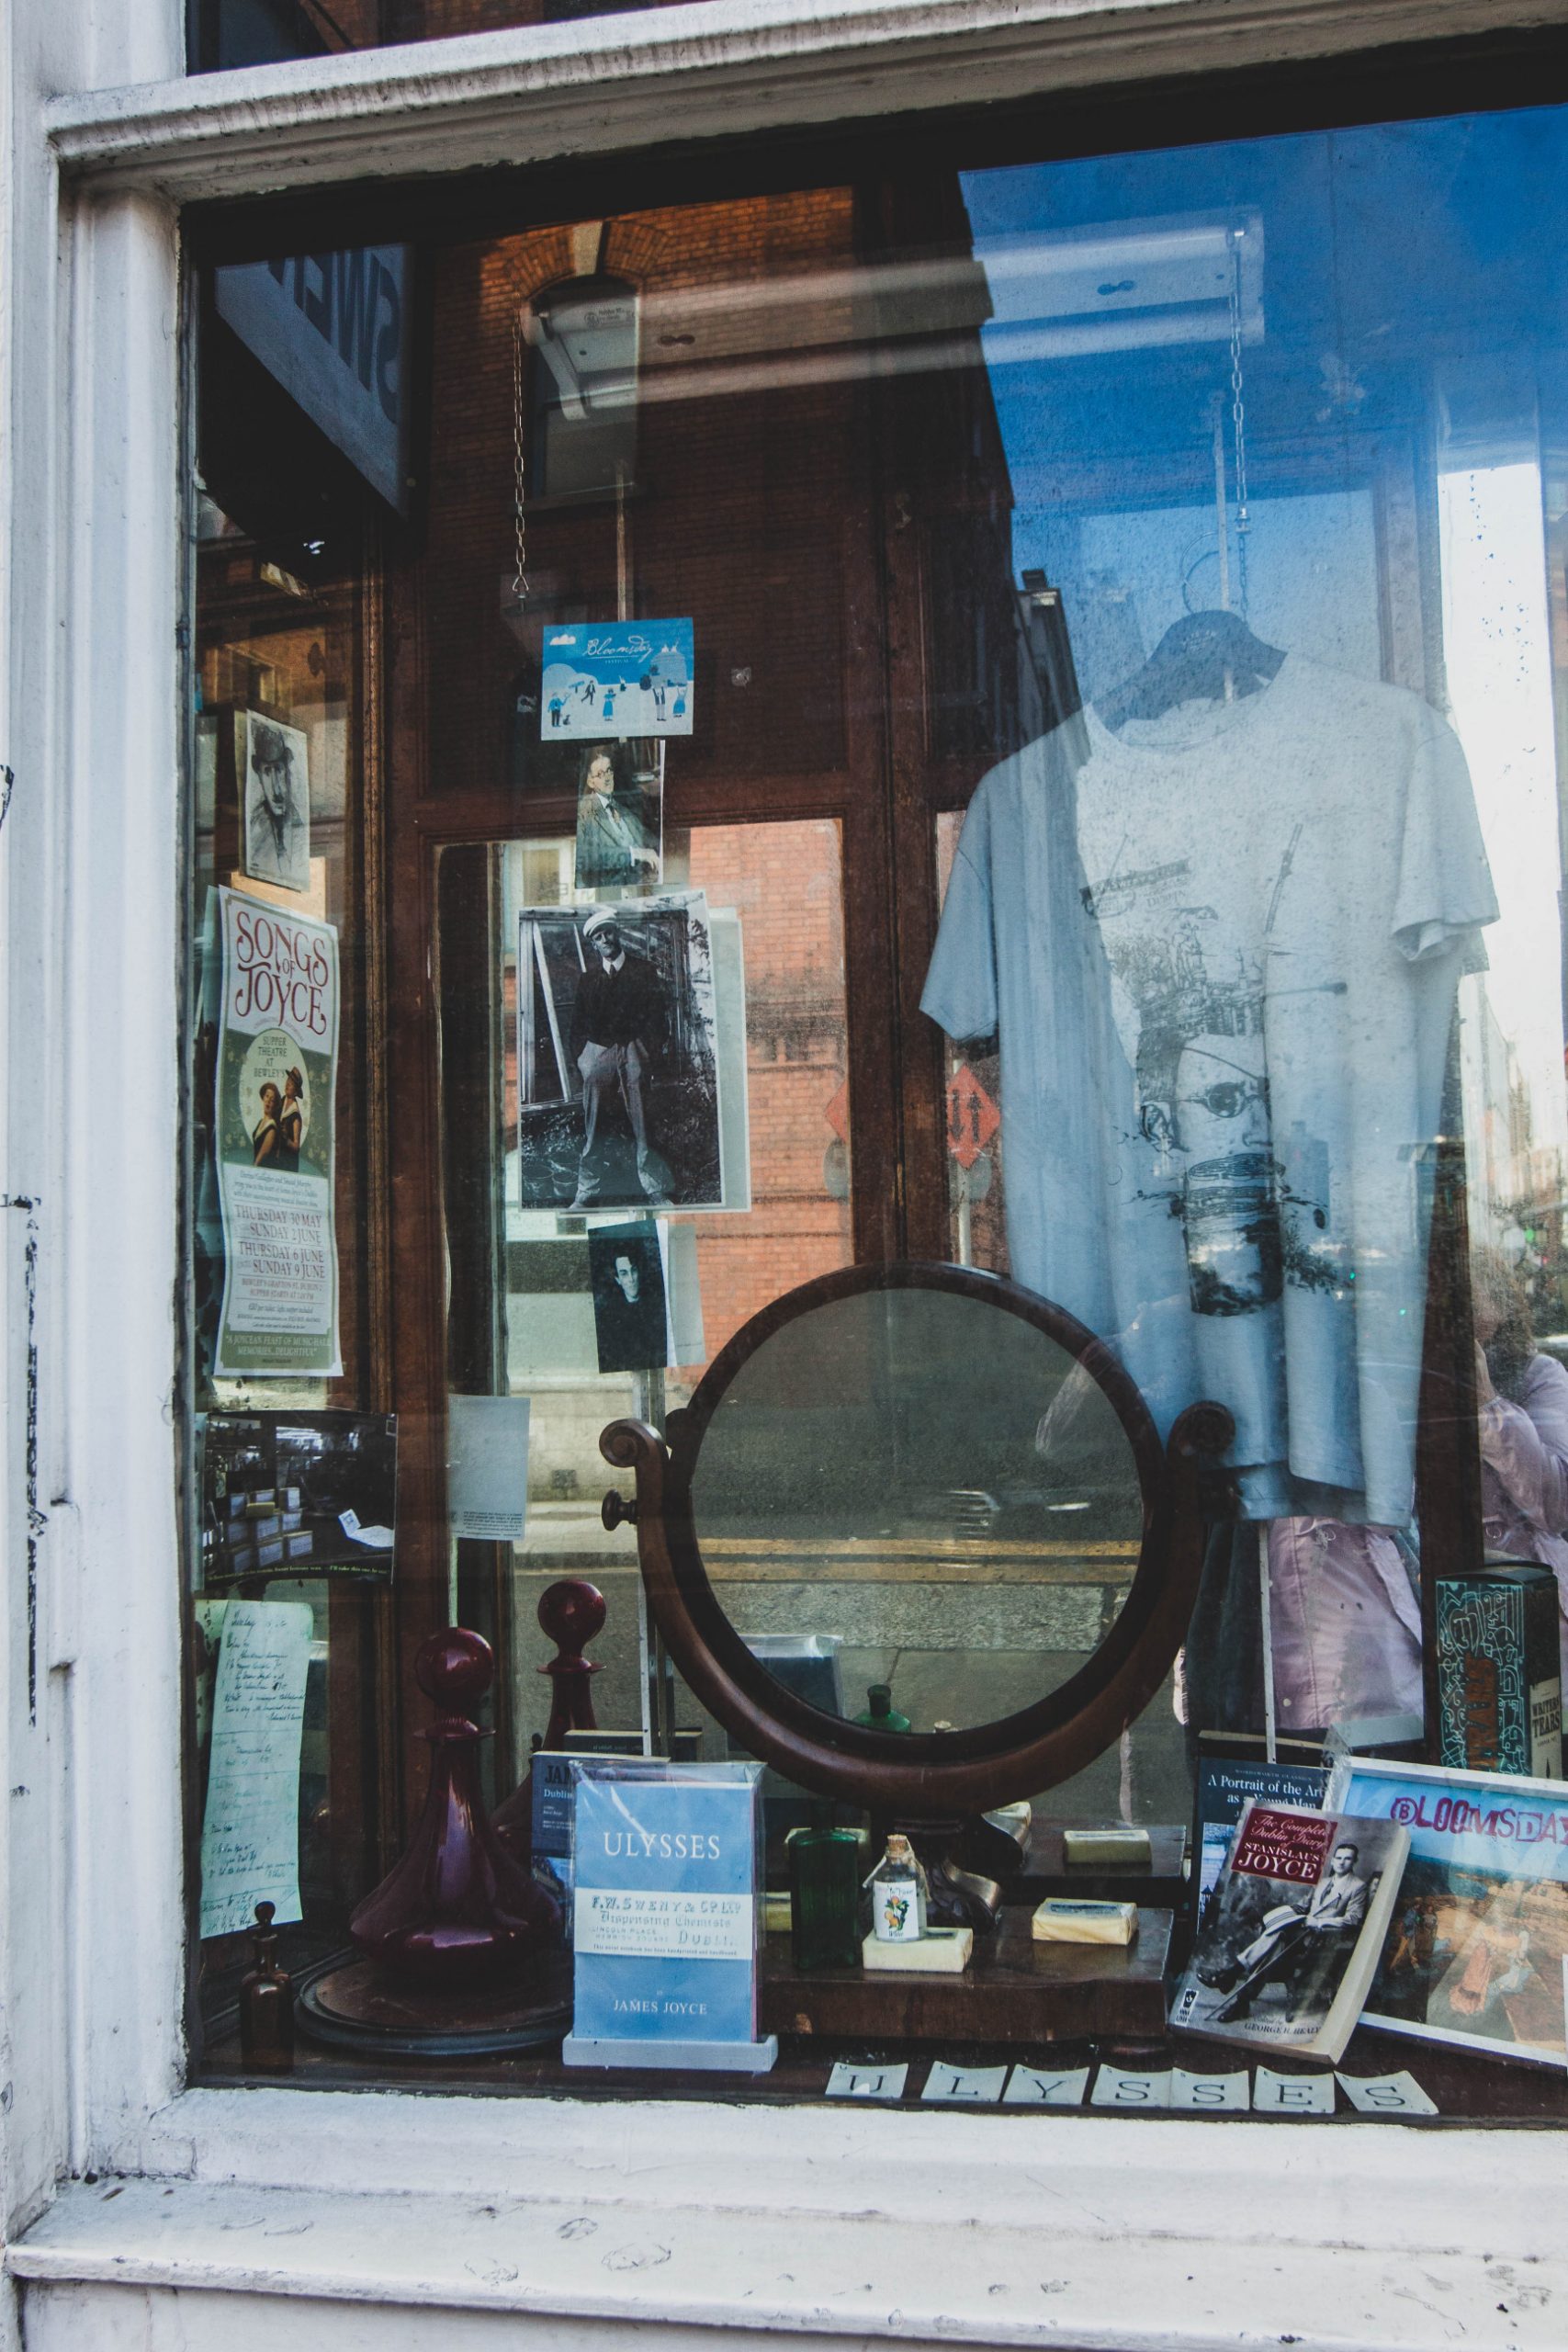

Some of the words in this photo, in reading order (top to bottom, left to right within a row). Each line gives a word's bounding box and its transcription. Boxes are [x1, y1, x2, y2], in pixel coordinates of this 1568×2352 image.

[582, 636, 654, 663] Bloomsday
[236, 910, 328, 987] SONGS
[282, 957, 295, 979] OF
[235, 961, 327, 1035] JOYCE
[263, 1035, 287, 1046] SUPPER
[258, 1046, 287, 1057] THEATRE
[265, 1057, 274, 1067] AT
[234, 1204, 287, 1224] THURSDAY
[301, 1213, 321, 1228] MAY
[250, 1221, 289, 1239] SUNDAY
[298, 1228, 321, 1244] JUNE
[238, 1241, 290, 1261] THURSDAY
[293, 1248, 299, 1261] 6
[300, 1248, 324, 1263] JUNE
[253, 1259, 292, 1276] SUNDAY
[294, 1263, 300, 1276] 9
[301, 1264, 325, 1280] JUNE
[1532, 1711, 1560, 1738] TEARS
[1208, 1774, 1217, 1786] A
[1221, 1776, 1265, 1792] Portrait
[1268, 1780, 1280, 1793] of
[1283, 1782, 1302, 1795] the
[1226, 1794, 1240, 1804] as
[1255, 1814, 1278, 1828] The
[603, 1831, 721, 1860] ULYSSES
[1250, 1825, 1288, 1841] Dublin
[1291, 1832, 1327, 1850] Diary
[1244, 1842, 1320, 1862] STANISLAUS
[1237, 1851, 1318, 1879] JOYCE
[675, 1913, 732, 1928] Chemists
[614, 1999, 659, 2012] JAMES
[663, 2002, 707, 2015] JOYCE
[1244, 2022, 1281, 2034] GEORGE
